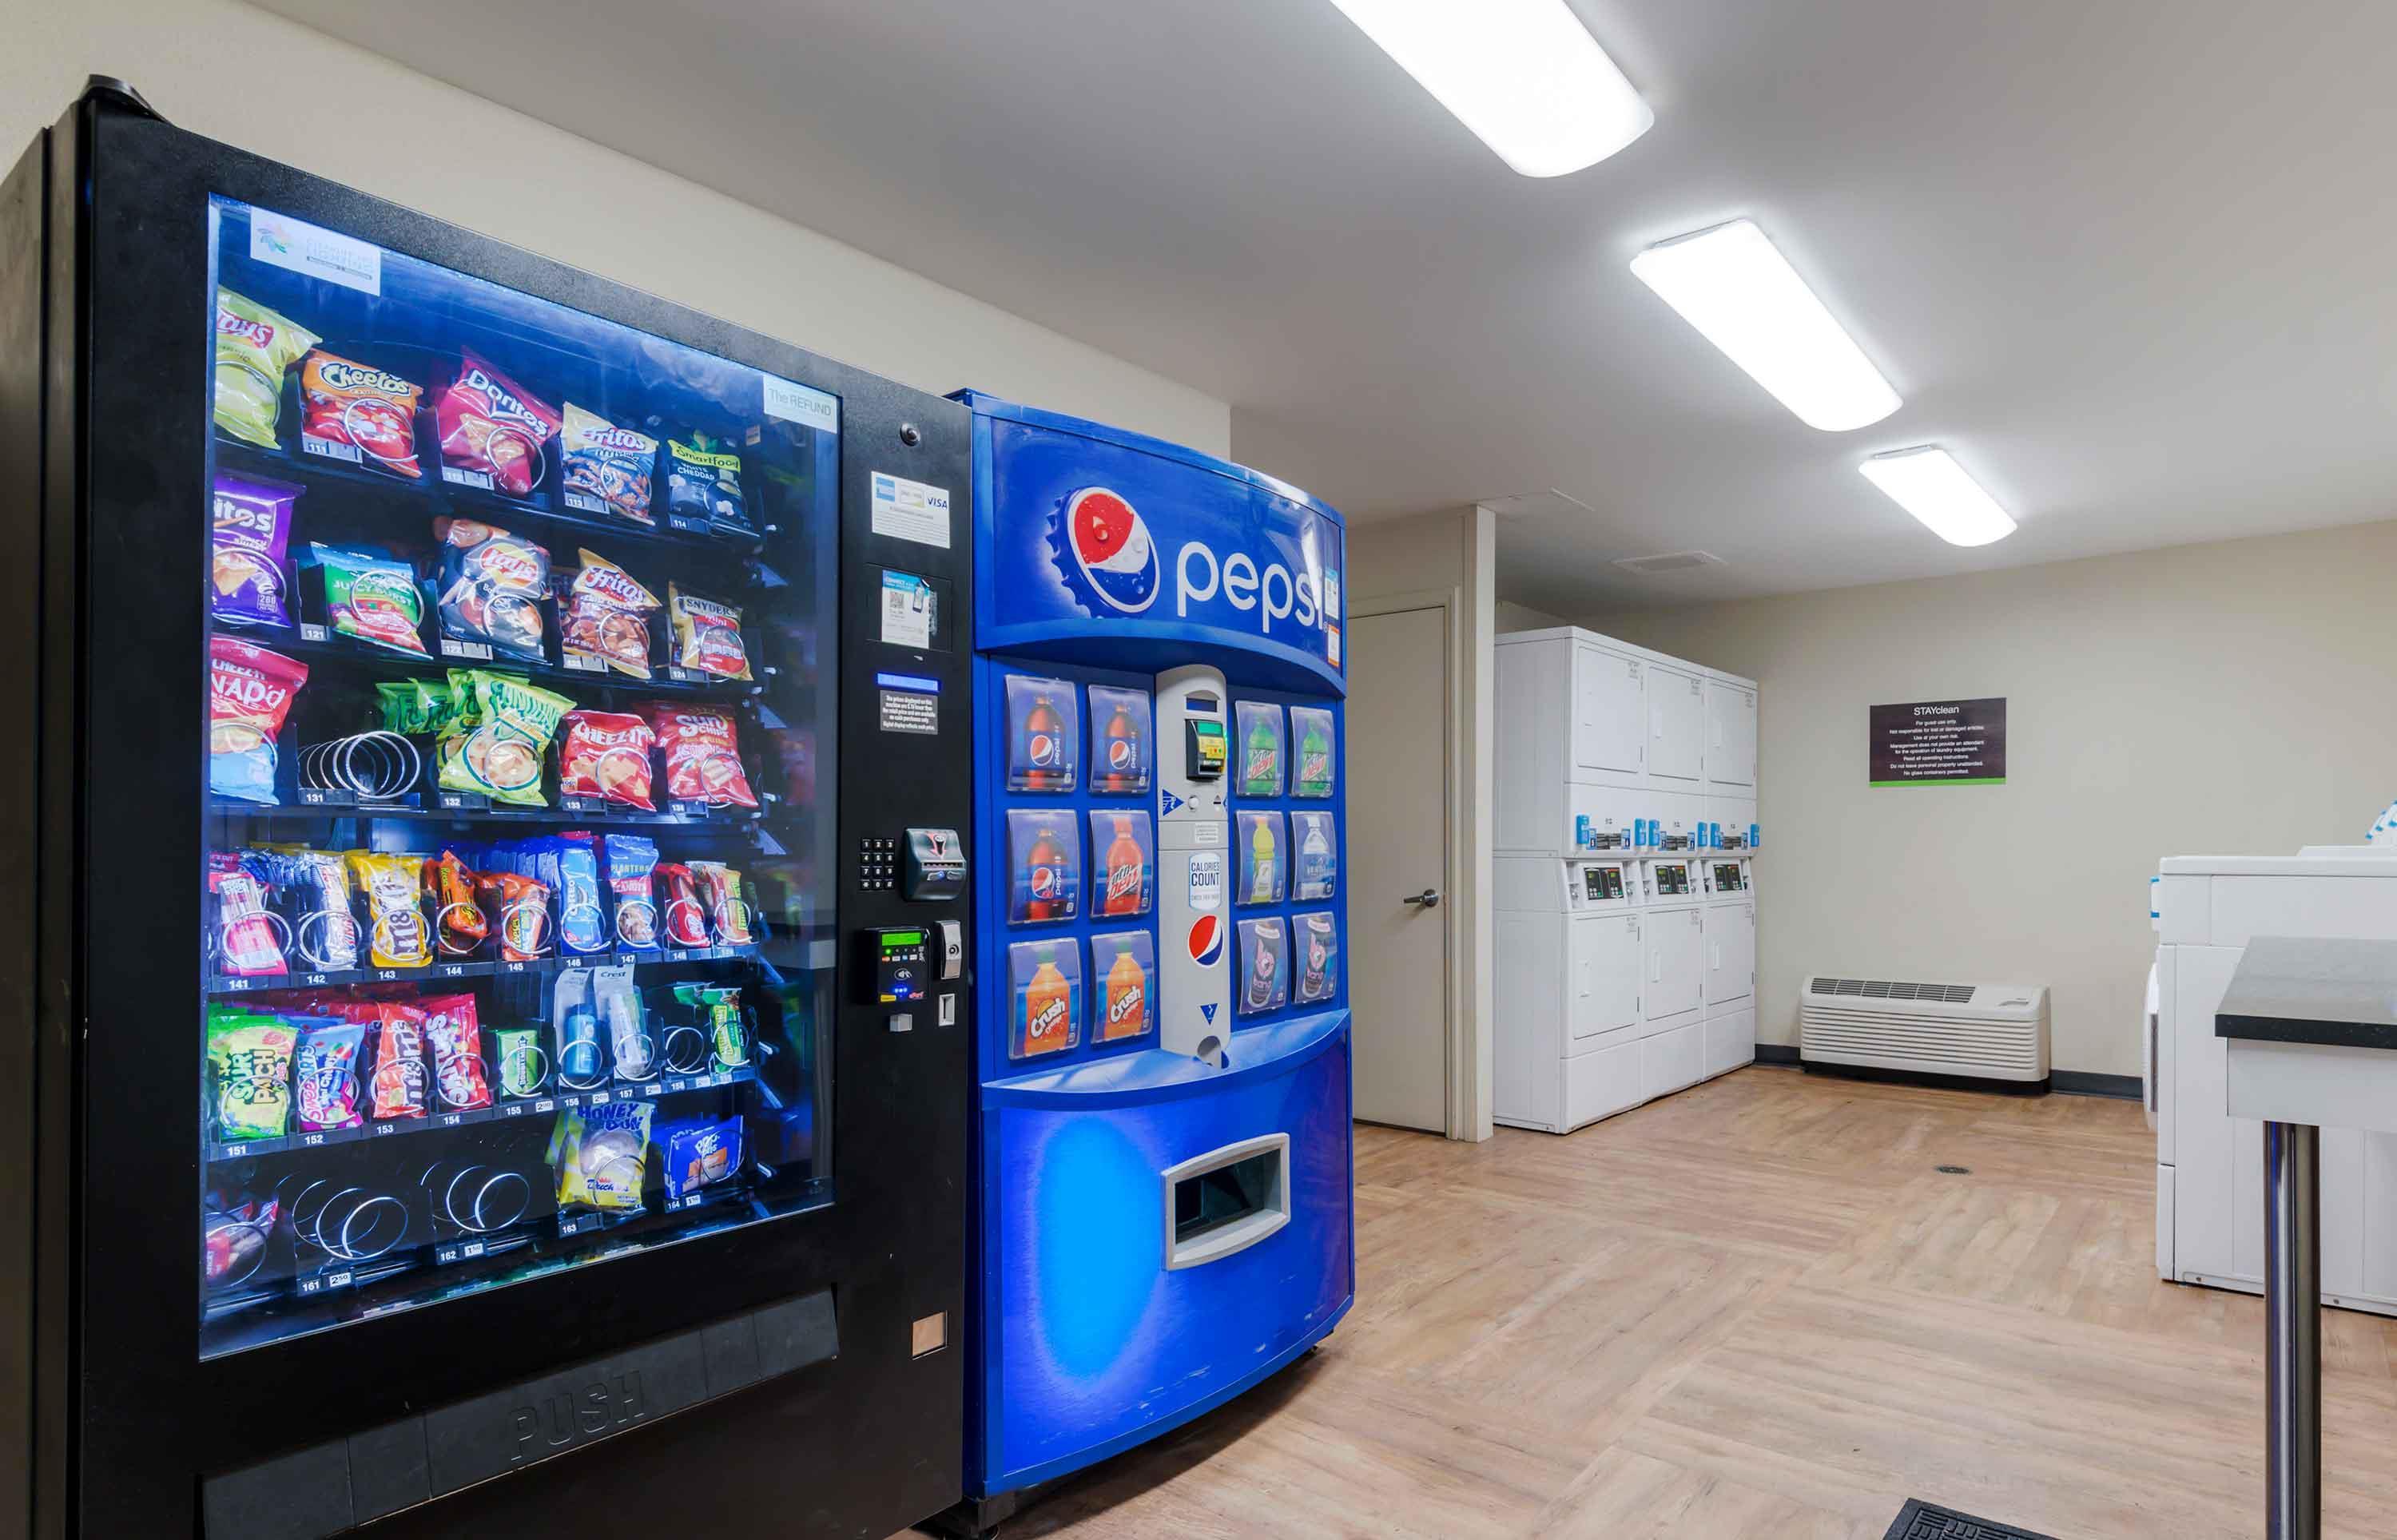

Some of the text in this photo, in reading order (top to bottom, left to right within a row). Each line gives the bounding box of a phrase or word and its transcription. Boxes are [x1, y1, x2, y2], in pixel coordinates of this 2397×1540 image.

[322, 363, 411, 395] Cheetos
[467, 369, 550, 436] Doritos
[789, 395, 831, 416] REFUND
[676, 446, 739, 468] Smartfood
[927, 497, 948, 510] VISA
[586, 566, 646, 602] Fritos
[1177, 542, 1323, 633] pepsi
[1914, 706, 1959, 716] STAYclean
[306, 794, 323, 803] 131
[444, 798, 461, 807] 132
[1191, 862, 1220, 872] CALORIES
[1191, 872, 1219, 887] COUNT
[446, 966, 462, 975] 144
[507, 963, 524, 971] 145
[307, 975, 327, 984] 142
[379, 970, 396, 979] 143
[229, 980, 248, 990] 141
[1110, 985, 1141, 1023] Crush
[1031, 997, 1066, 1038] Crush
[577, 1103, 639, 1119] HONEY
[443, 1116, 460, 1125] 154
[376, 1125, 394, 1133] 153
[305, 1134, 324, 1144] 152
[228, 1145, 247, 1156] 151
[562, 1223, 577, 1234] 163
[440, 1251, 457, 1261] 162
[302, 1281, 320, 1292] 161
[510, 1369, 645, 1461] PUSH
